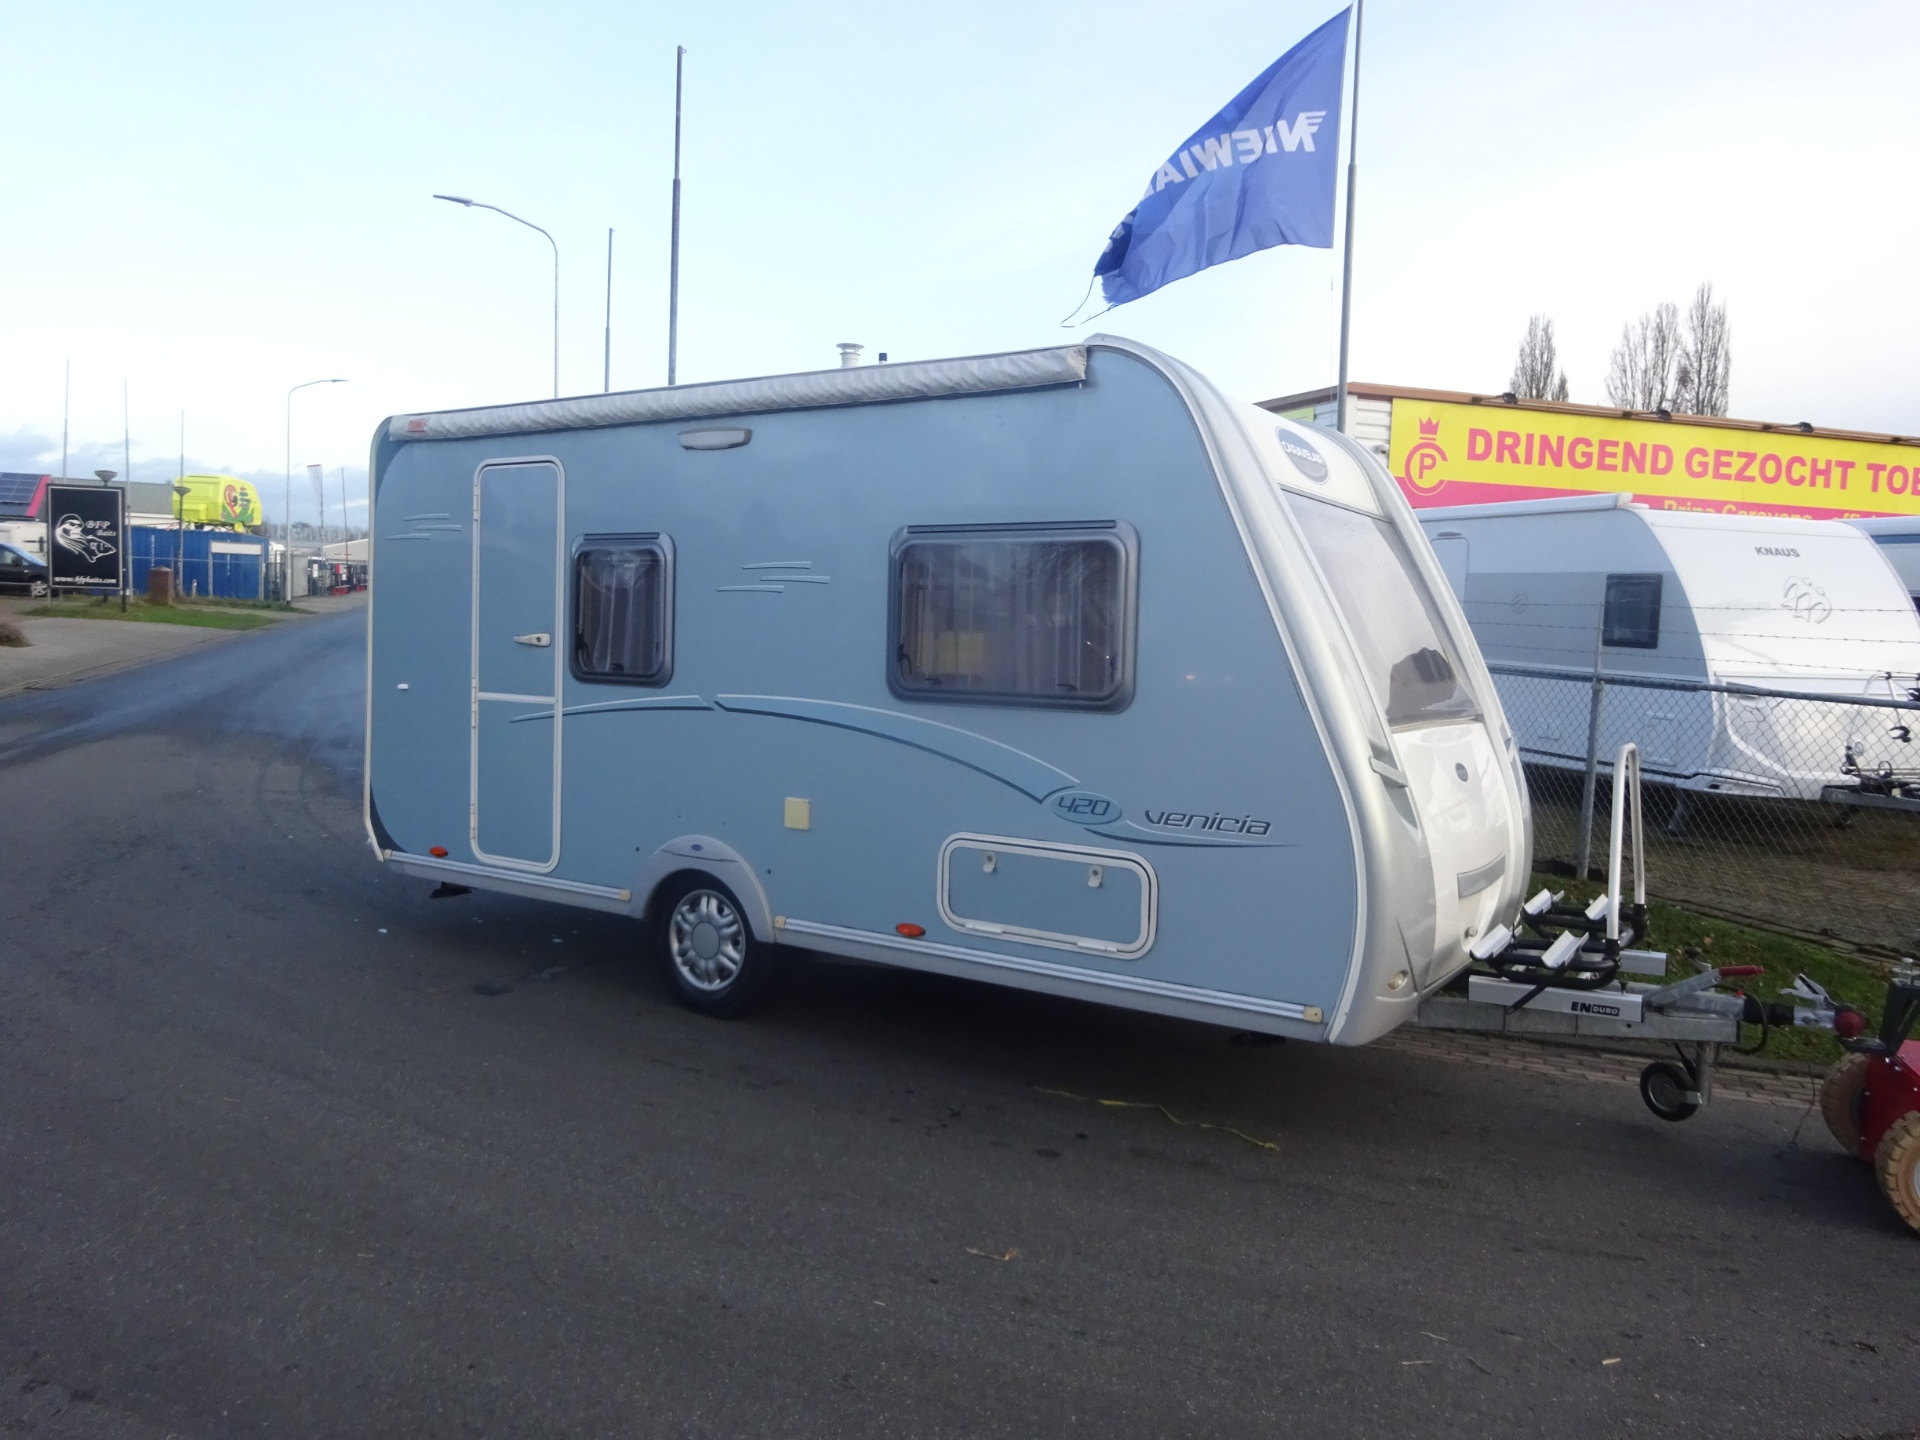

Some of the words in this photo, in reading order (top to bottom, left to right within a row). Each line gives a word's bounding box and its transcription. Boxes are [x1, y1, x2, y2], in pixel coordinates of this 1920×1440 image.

[1466, 427, 1674, 476] DRINGEND
[1684, 446, 1856, 490] GEZOCHT
[1754, 546, 1800, 558] KNAUS
[1058, 796, 1111, 816] 420
[1144, 809, 1272, 836] venicia
